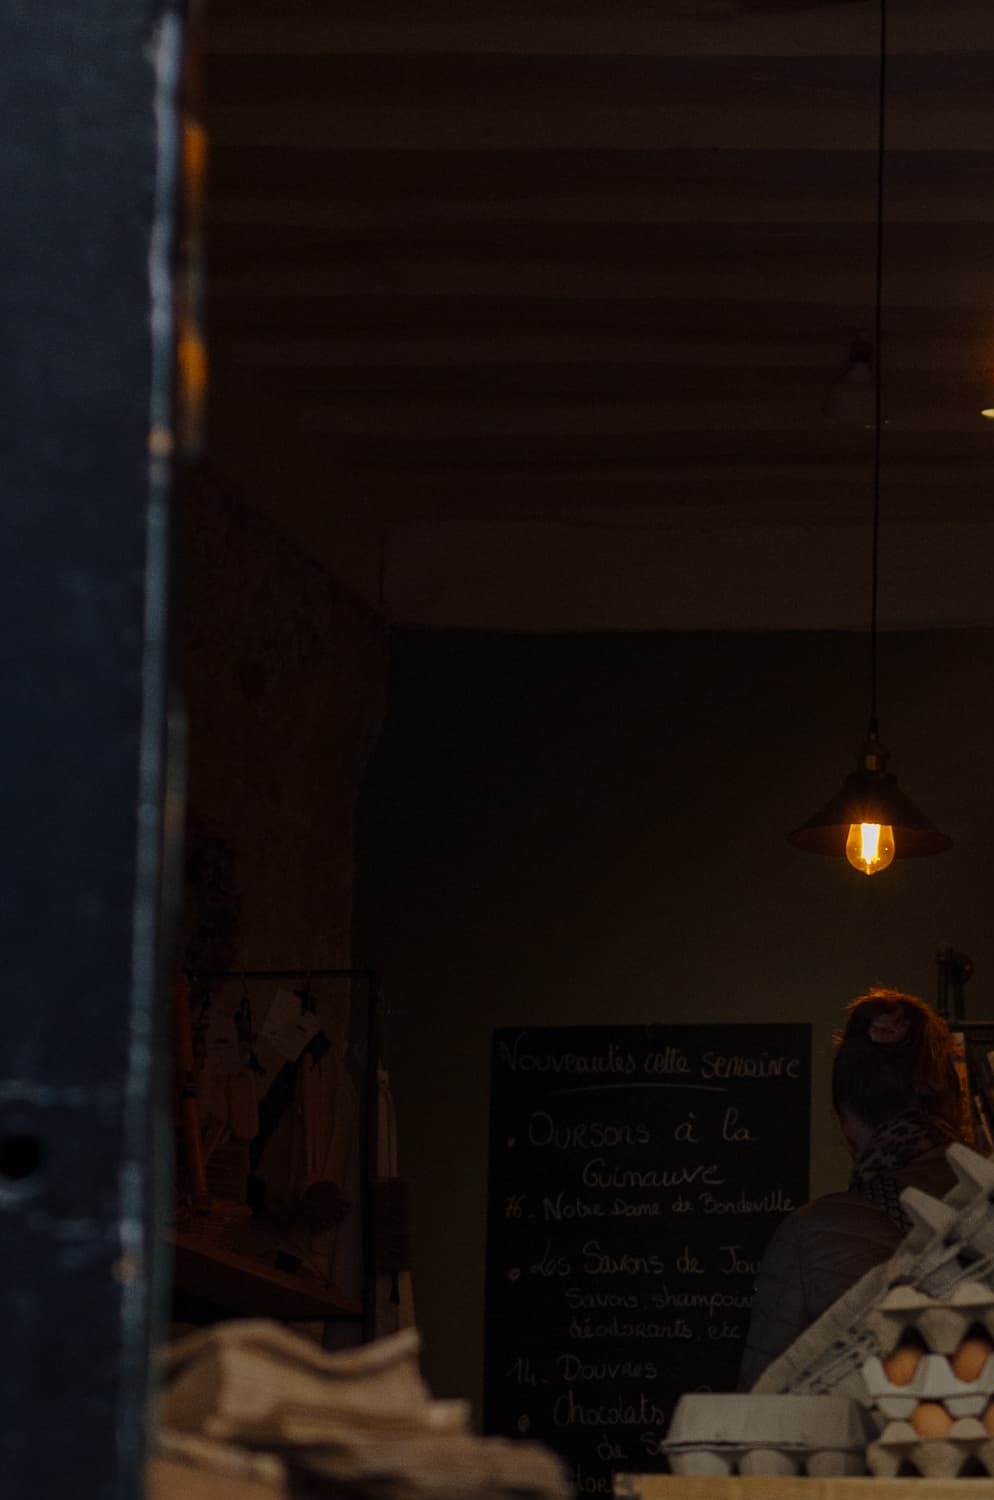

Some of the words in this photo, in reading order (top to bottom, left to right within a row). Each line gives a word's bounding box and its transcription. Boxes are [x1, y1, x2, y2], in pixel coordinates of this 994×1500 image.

[674, 1112, 701, 1143] à
[722, 1106, 759, 1142] la
[673, 1245, 705, 1275] de
